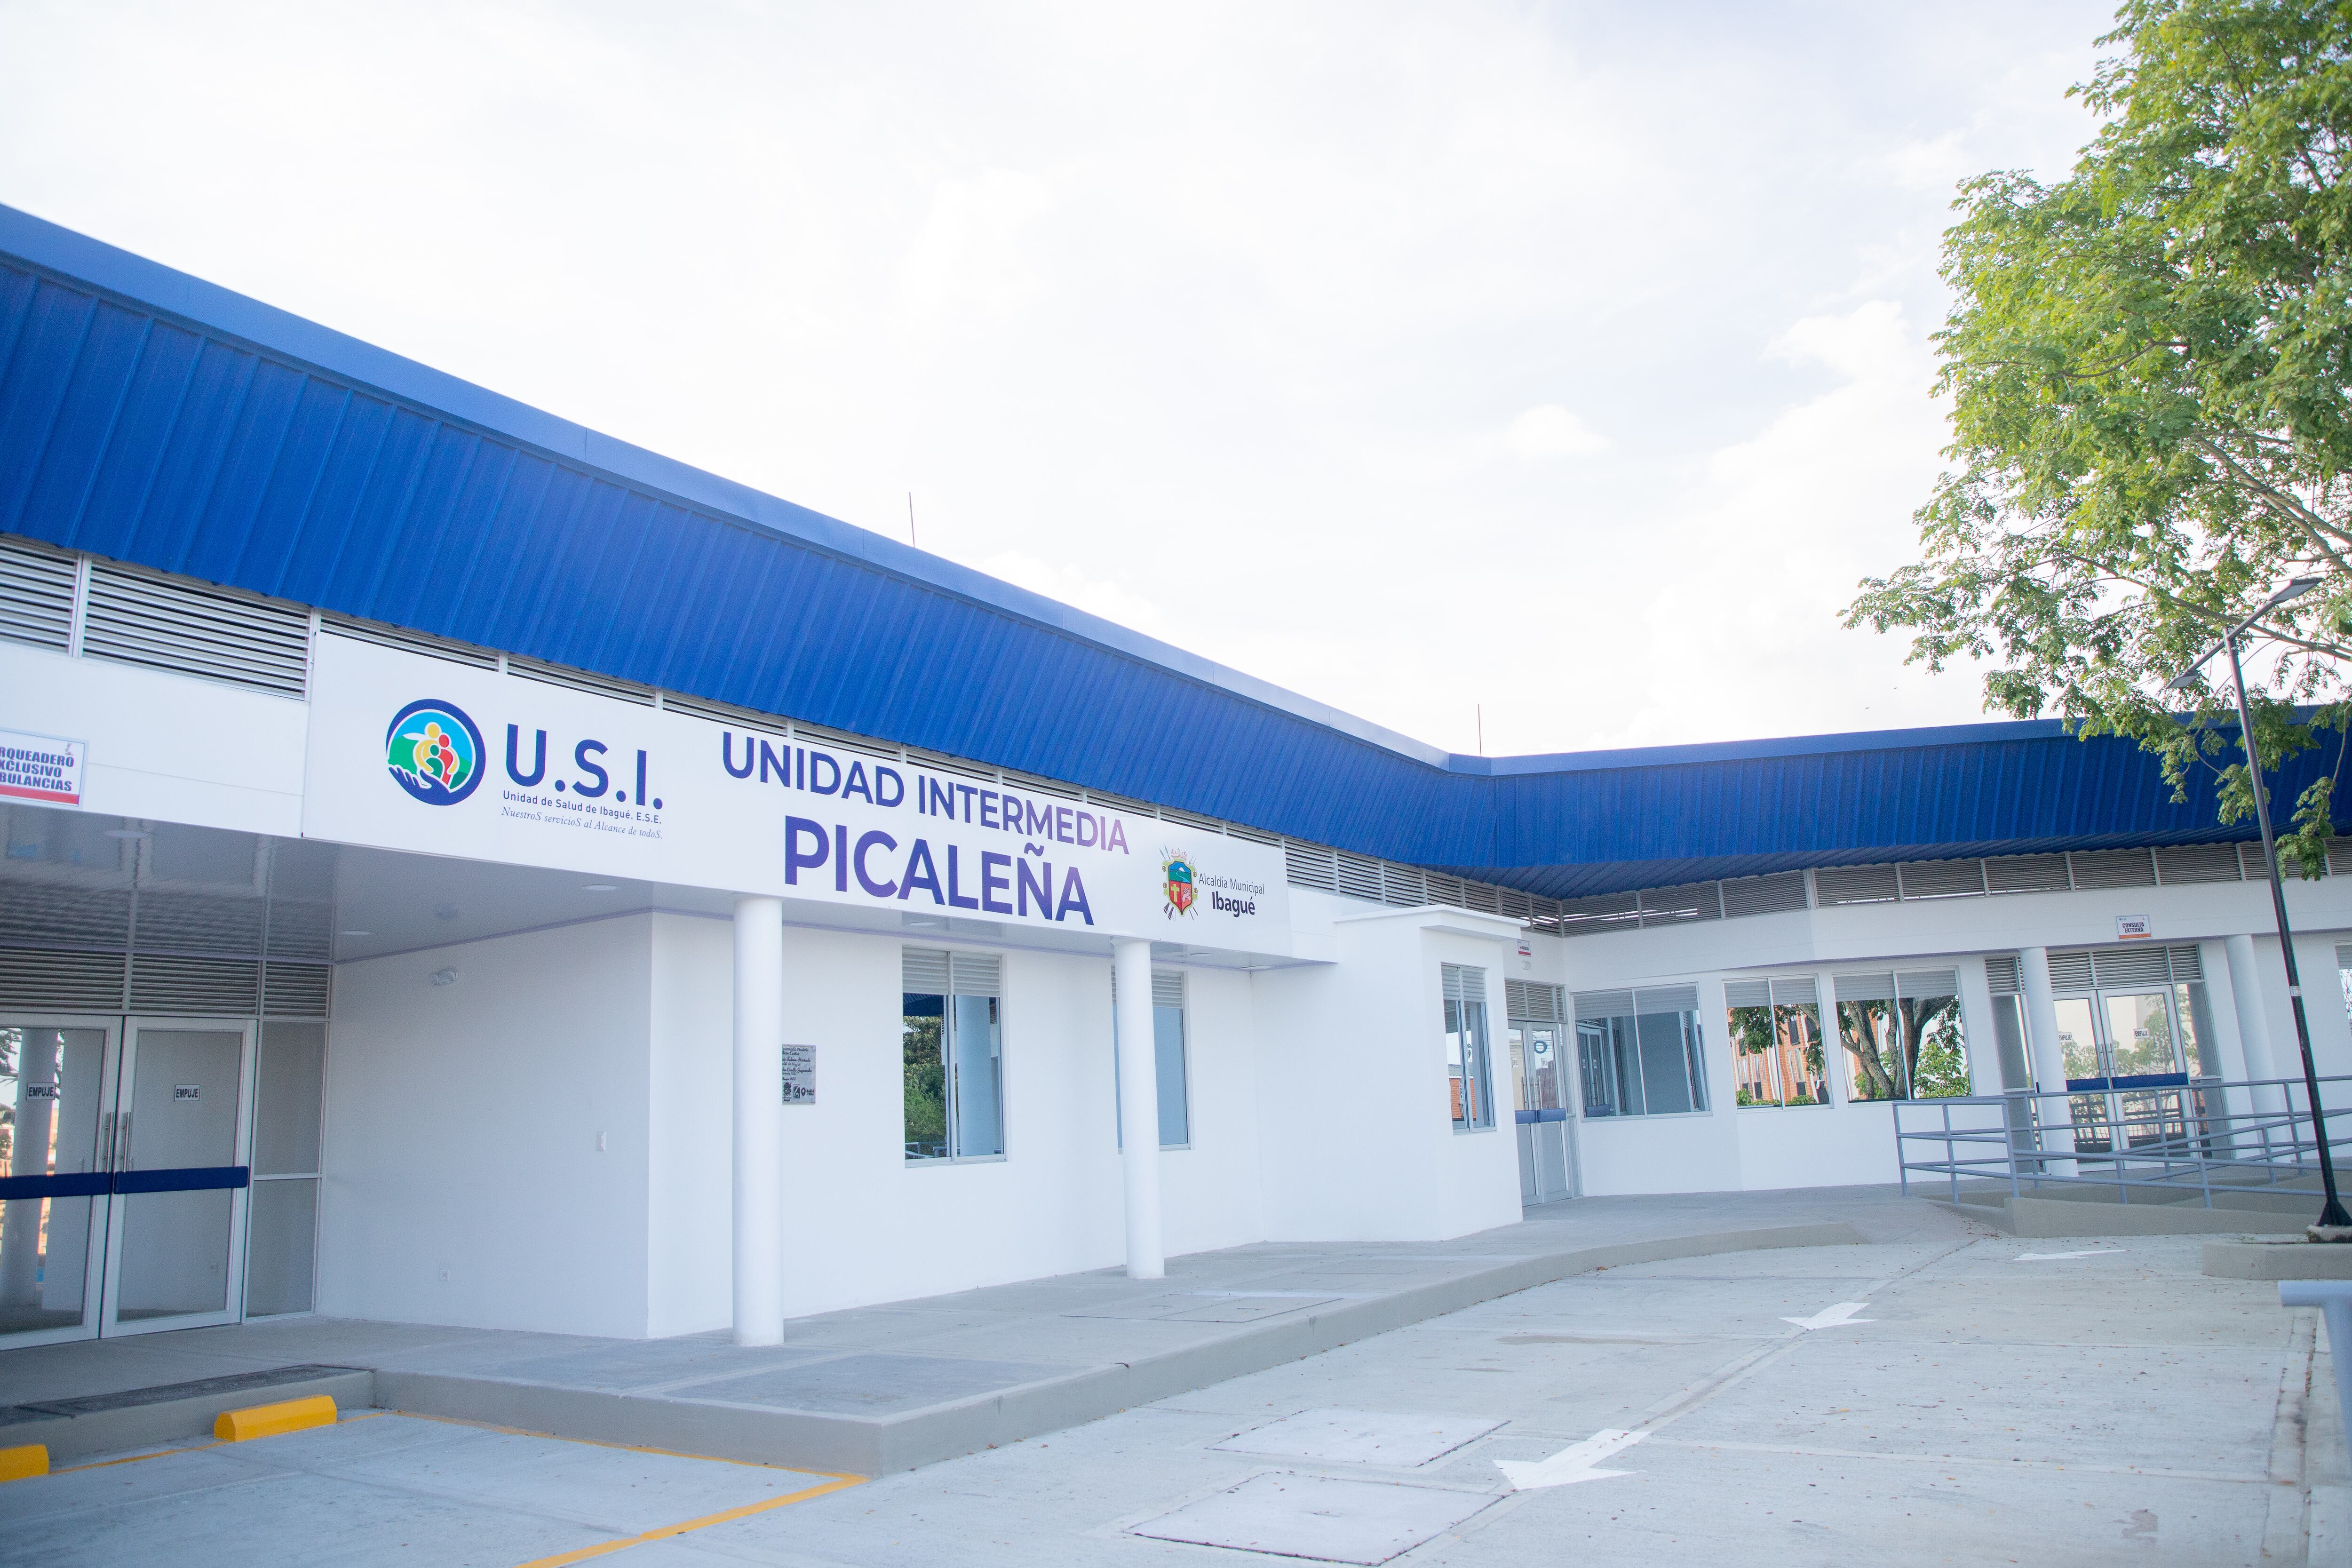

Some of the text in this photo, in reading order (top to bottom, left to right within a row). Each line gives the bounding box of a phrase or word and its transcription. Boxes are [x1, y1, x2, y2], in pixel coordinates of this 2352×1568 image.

[506, 723, 663, 810] U.S.I.
[503, 790, 661, 824] Unidad de Salud de Ibagué. E.S.E.
[723, 731, 1129, 855] UNIDAD INTERMEDIA
[501, 806, 662, 839] NuestroS servicioS al Alcance de todoS.
[785, 815, 1094, 926] PICALEÑA
[1199, 873, 1265, 896] Alcaldía Municipal
[1212, 891, 1255, 917] Ibagué
[29, 1087, 54, 1097] EMPUJE
[176, 1088, 199, 1098] EMPUJE
